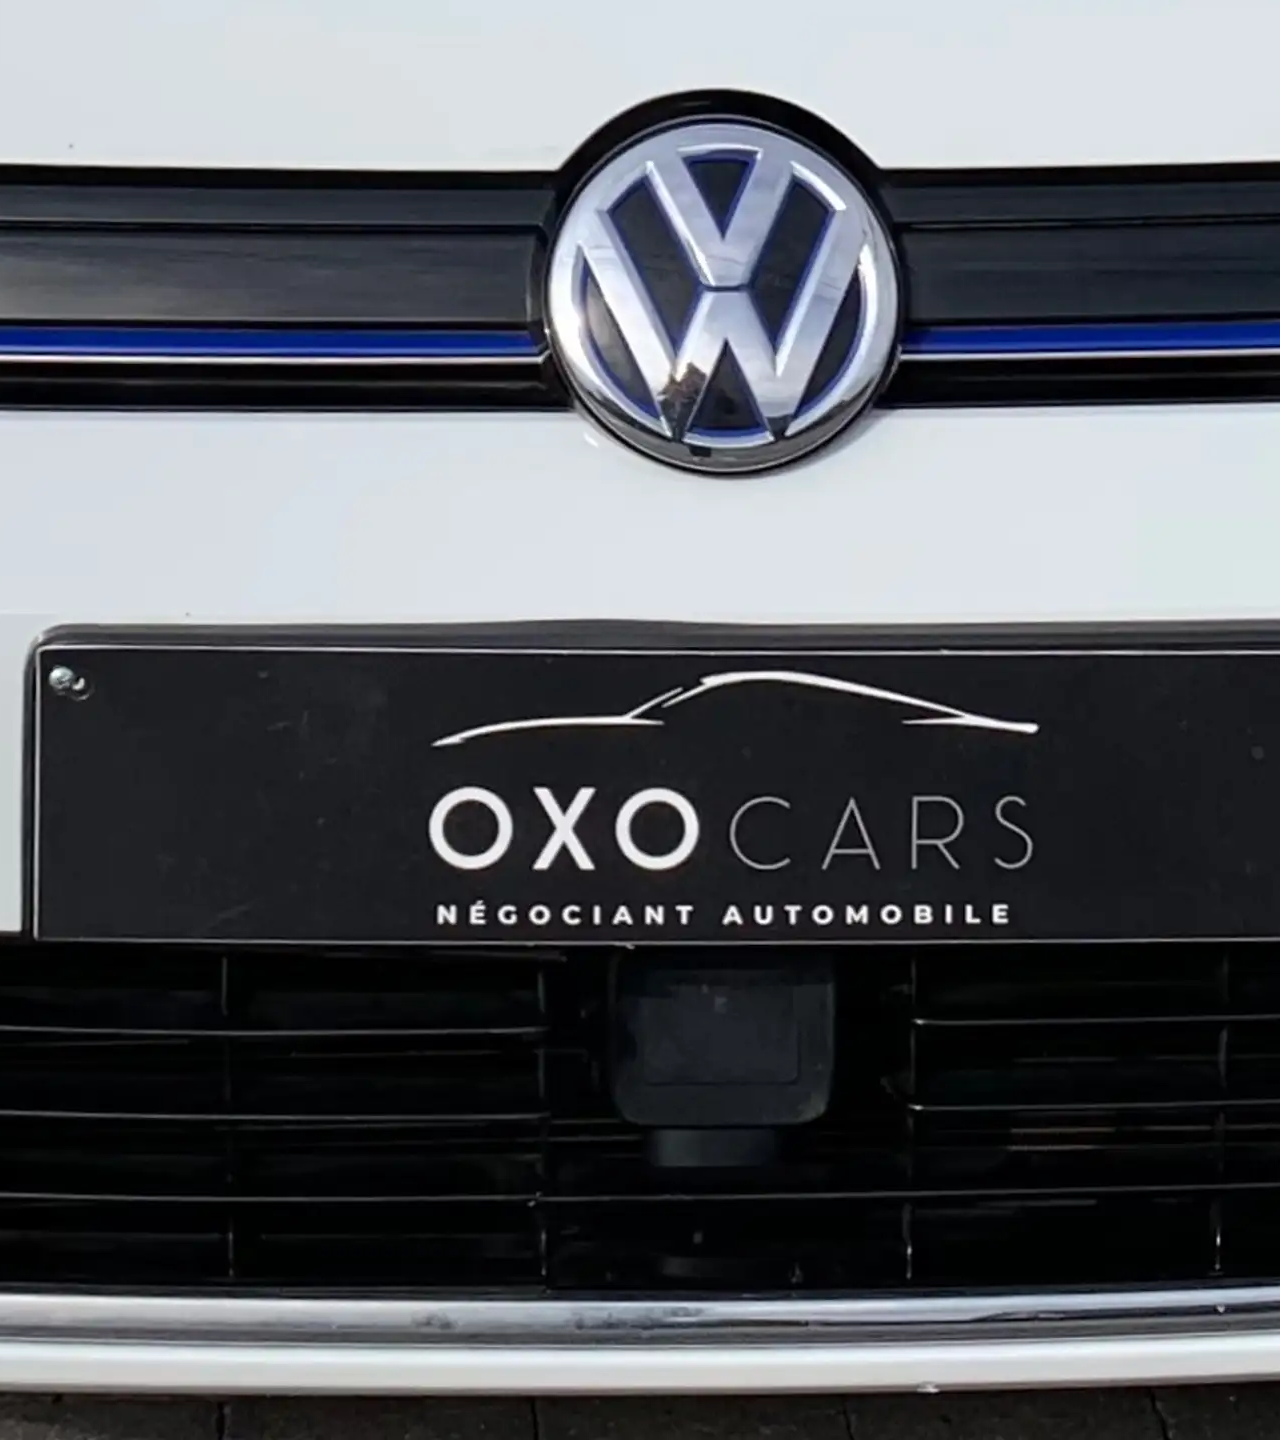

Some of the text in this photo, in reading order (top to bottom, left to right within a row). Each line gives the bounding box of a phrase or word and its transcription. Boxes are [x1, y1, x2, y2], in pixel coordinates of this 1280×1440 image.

[559, 125, 889, 455] VW
[436, 899, 1010, 926] NÉGOCIANT AUTOMOBILE
